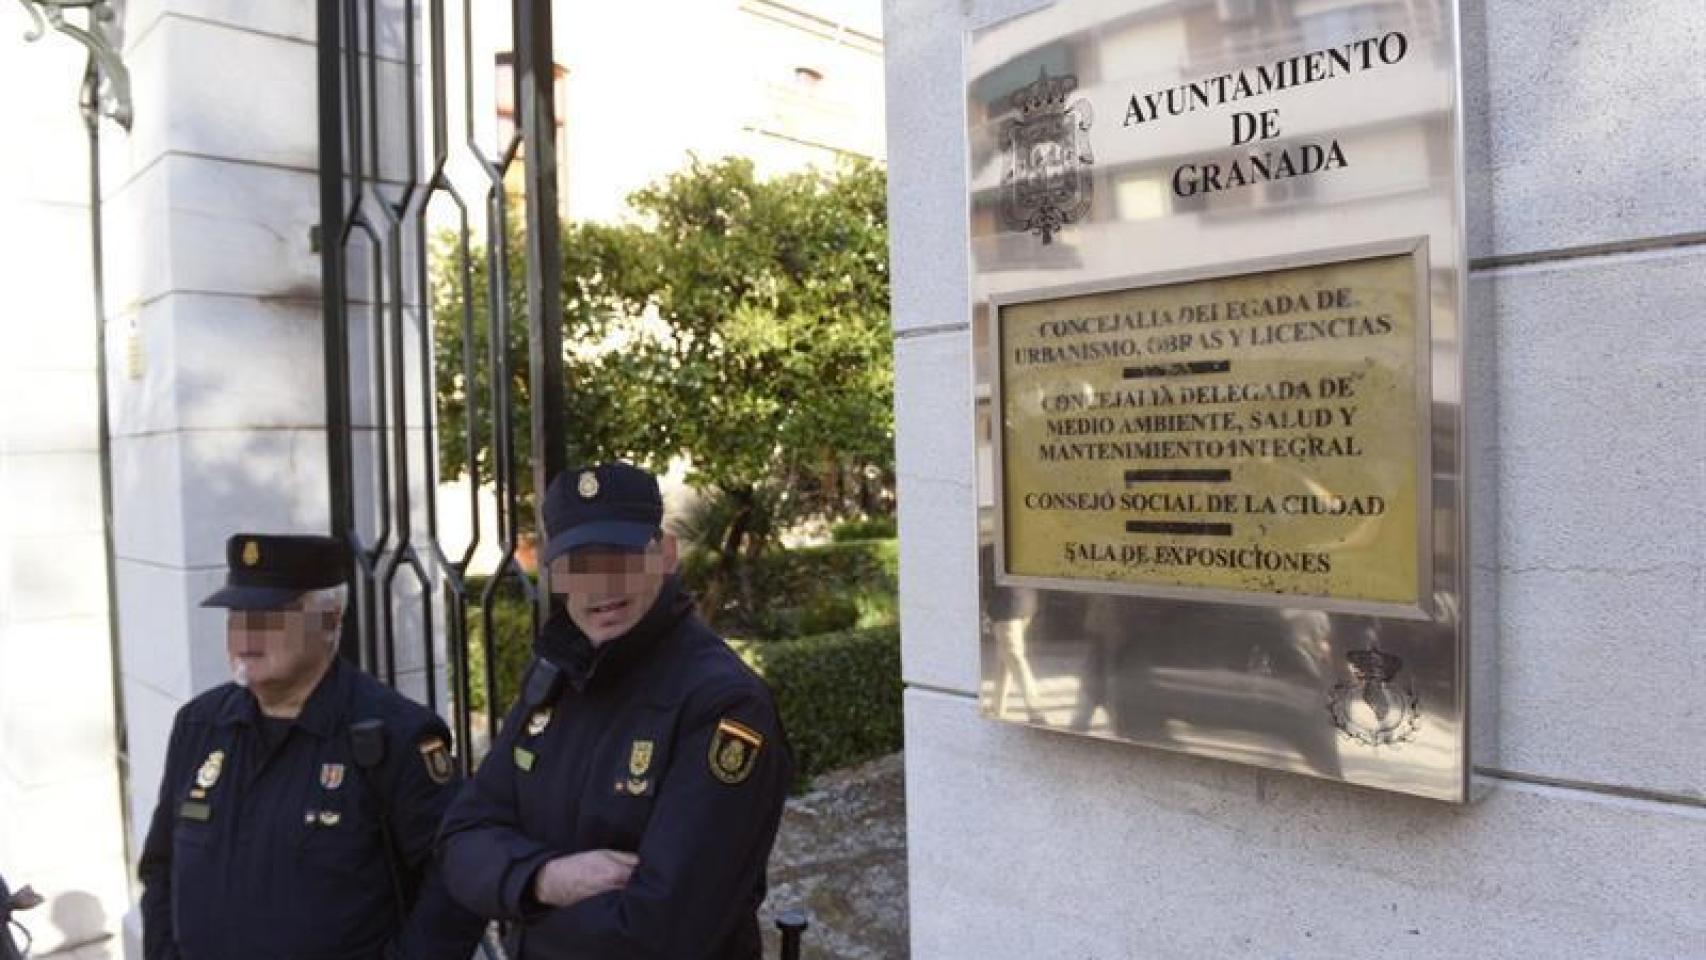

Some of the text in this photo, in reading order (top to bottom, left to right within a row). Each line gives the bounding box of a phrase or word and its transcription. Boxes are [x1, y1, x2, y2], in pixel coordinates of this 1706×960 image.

[1123, 31, 1408, 127] AYUNTAMIENTO
[1231, 108, 1281, 145] DE
[1172, 138, 1349, 197] GRANADA
[1179, 294, 1311, 324] DELEGADA
[1315, 287, 1353, 311] DE
[1228, 327, 1244, 348] Y
[1250, 313, 1393, 347] LICENCIAS
[1181, 380, 1313, 405] DELEGADA
[1319, 375, 1355, 399] DE
[1046, 405, 1358, 437] MEDIO AMBIENTE, SALUD Y
[1039, 436, 1363, 461] MANTENIMIENTO INTEGRAL
[1024, 491, 1386, 517] CONSEJO SOCIAL DE LA CIUDAD
[1064, 542, 1331, 574] SALA DE EXPOSICIONES
